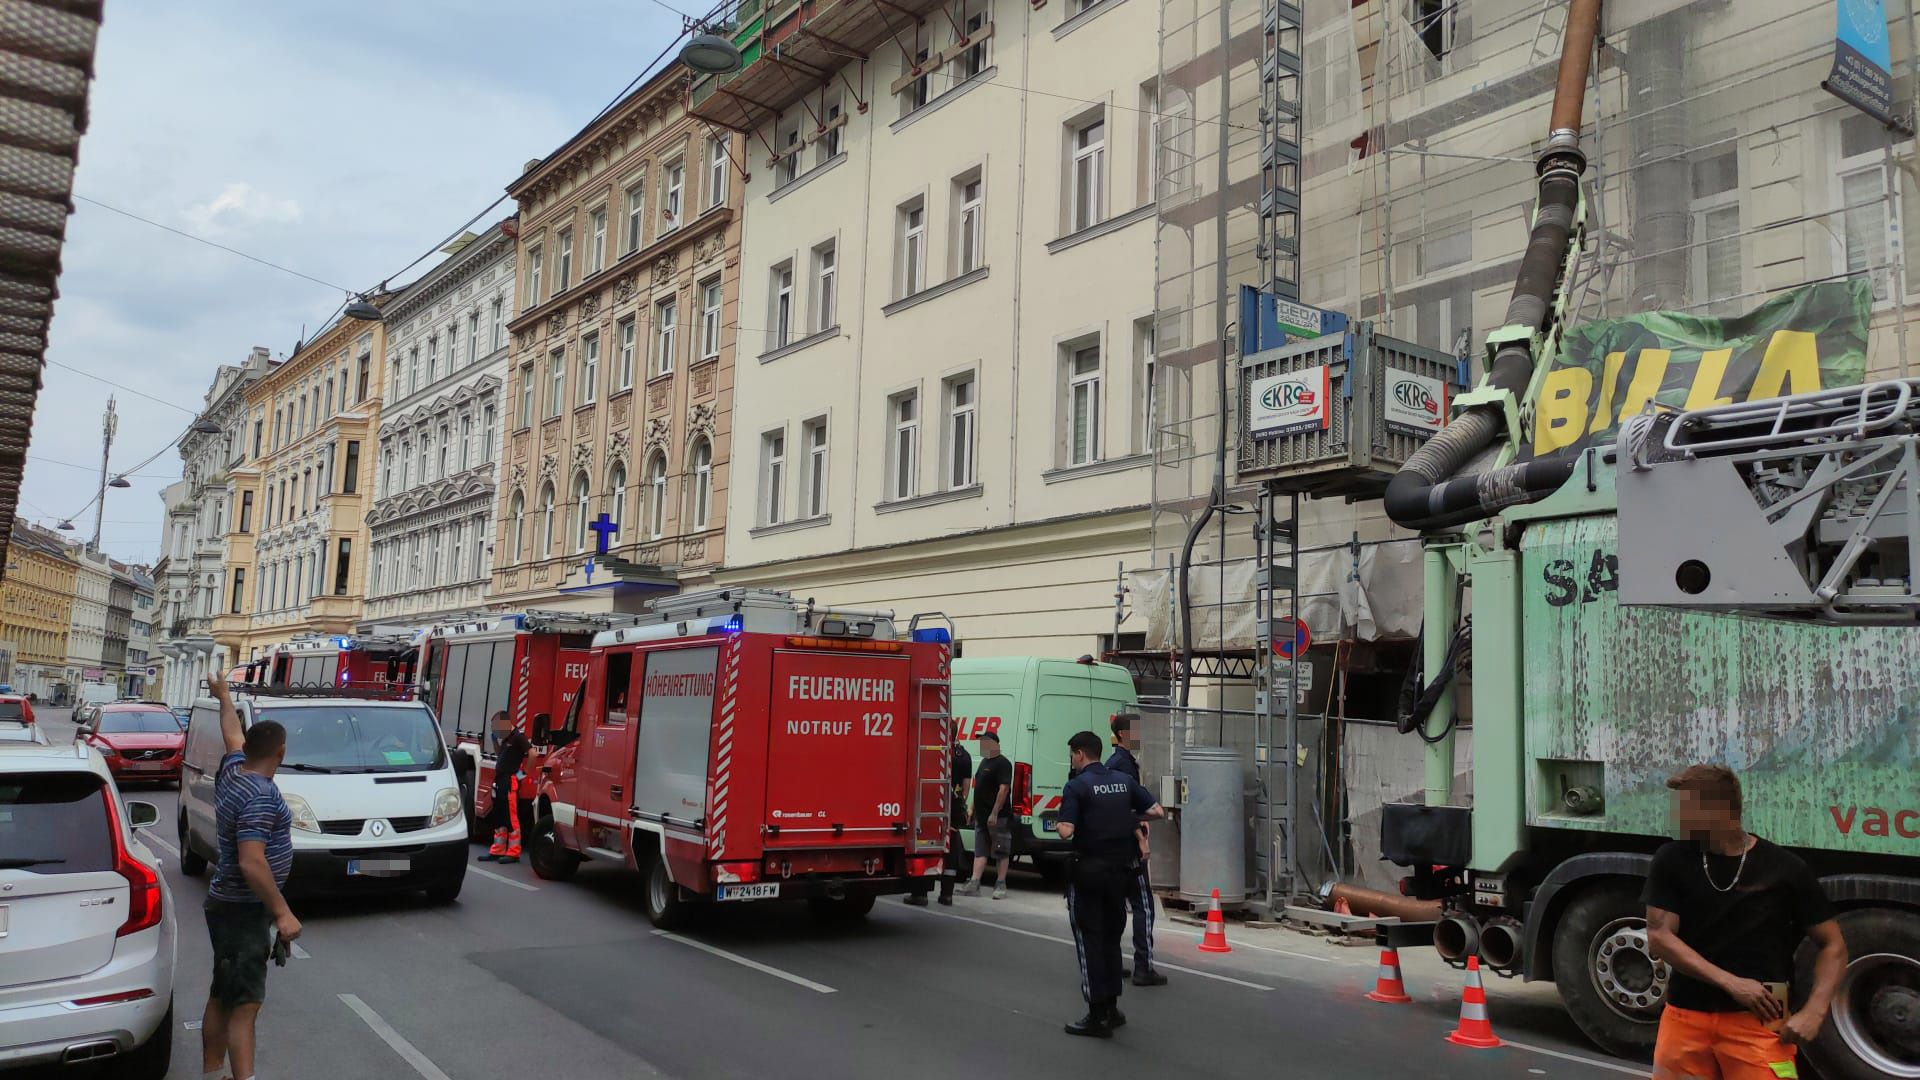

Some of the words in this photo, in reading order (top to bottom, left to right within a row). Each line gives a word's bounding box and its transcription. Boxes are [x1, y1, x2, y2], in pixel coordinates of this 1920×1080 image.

[1262, 384, 1305, 408] EKRO
[1395, 383, 1430, 408] EKRO
[1534, 329, 1821, 457] BILLA
[645, 669, 714, 697] HÖHENRETTUNG
[788, 675, 895, 702] FEUERWEHR
[786, 719, 853, 736] NOTRUF
[862, 712, 894, 737] 122
[954, 716, 1002, 741] LER
[1093, 783, 1128, 795] POLIZEI
[877, 803, 901, 817] 190
[739, 884, 761, 897] 2418
